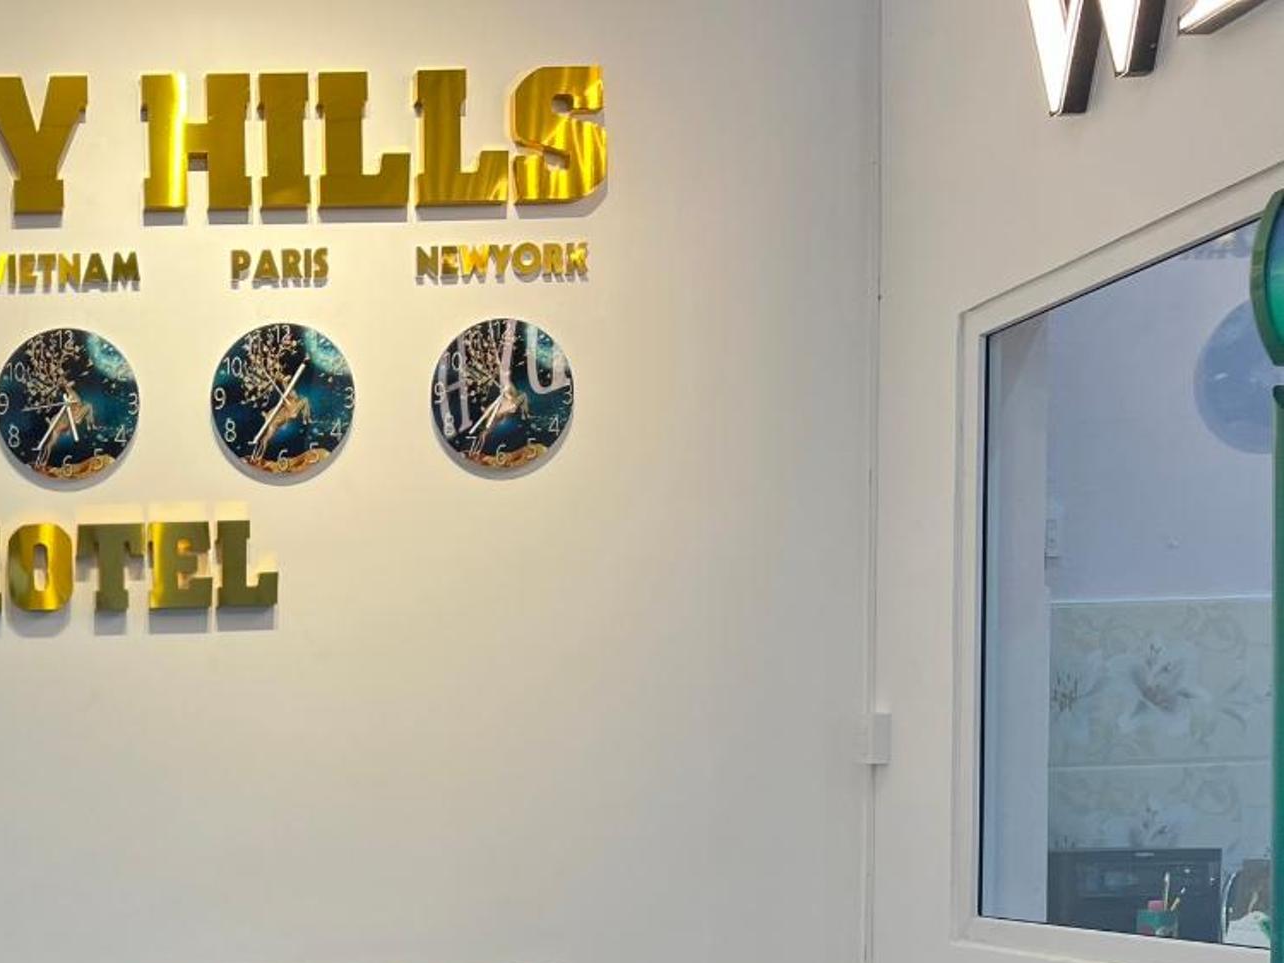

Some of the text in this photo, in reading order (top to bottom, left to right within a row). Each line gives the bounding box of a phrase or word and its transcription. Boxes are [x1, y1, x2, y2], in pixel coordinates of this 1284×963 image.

[140, 65, 606, 211] HILLS
[230, 246, 329, 282] PARIS
[415, 241, 589, 280] NEWYORK
[7, 362, 24, 382] 10
[224, 357, 243, 377] 10
[128, 393, 139, 415] 3
[214, 388, 226, 410] 9
[344, 387, 354, 409] 3
[562, 383, 573, 405] 3
[8, 424, 20, 448] 8
[114, 424, 127, 446] 4
[224, 418, 237, 442] 8
[330, 418, 342, 441] 4
[549, 414, 560, 436] 4
[496, 445, 507, 465] 6
